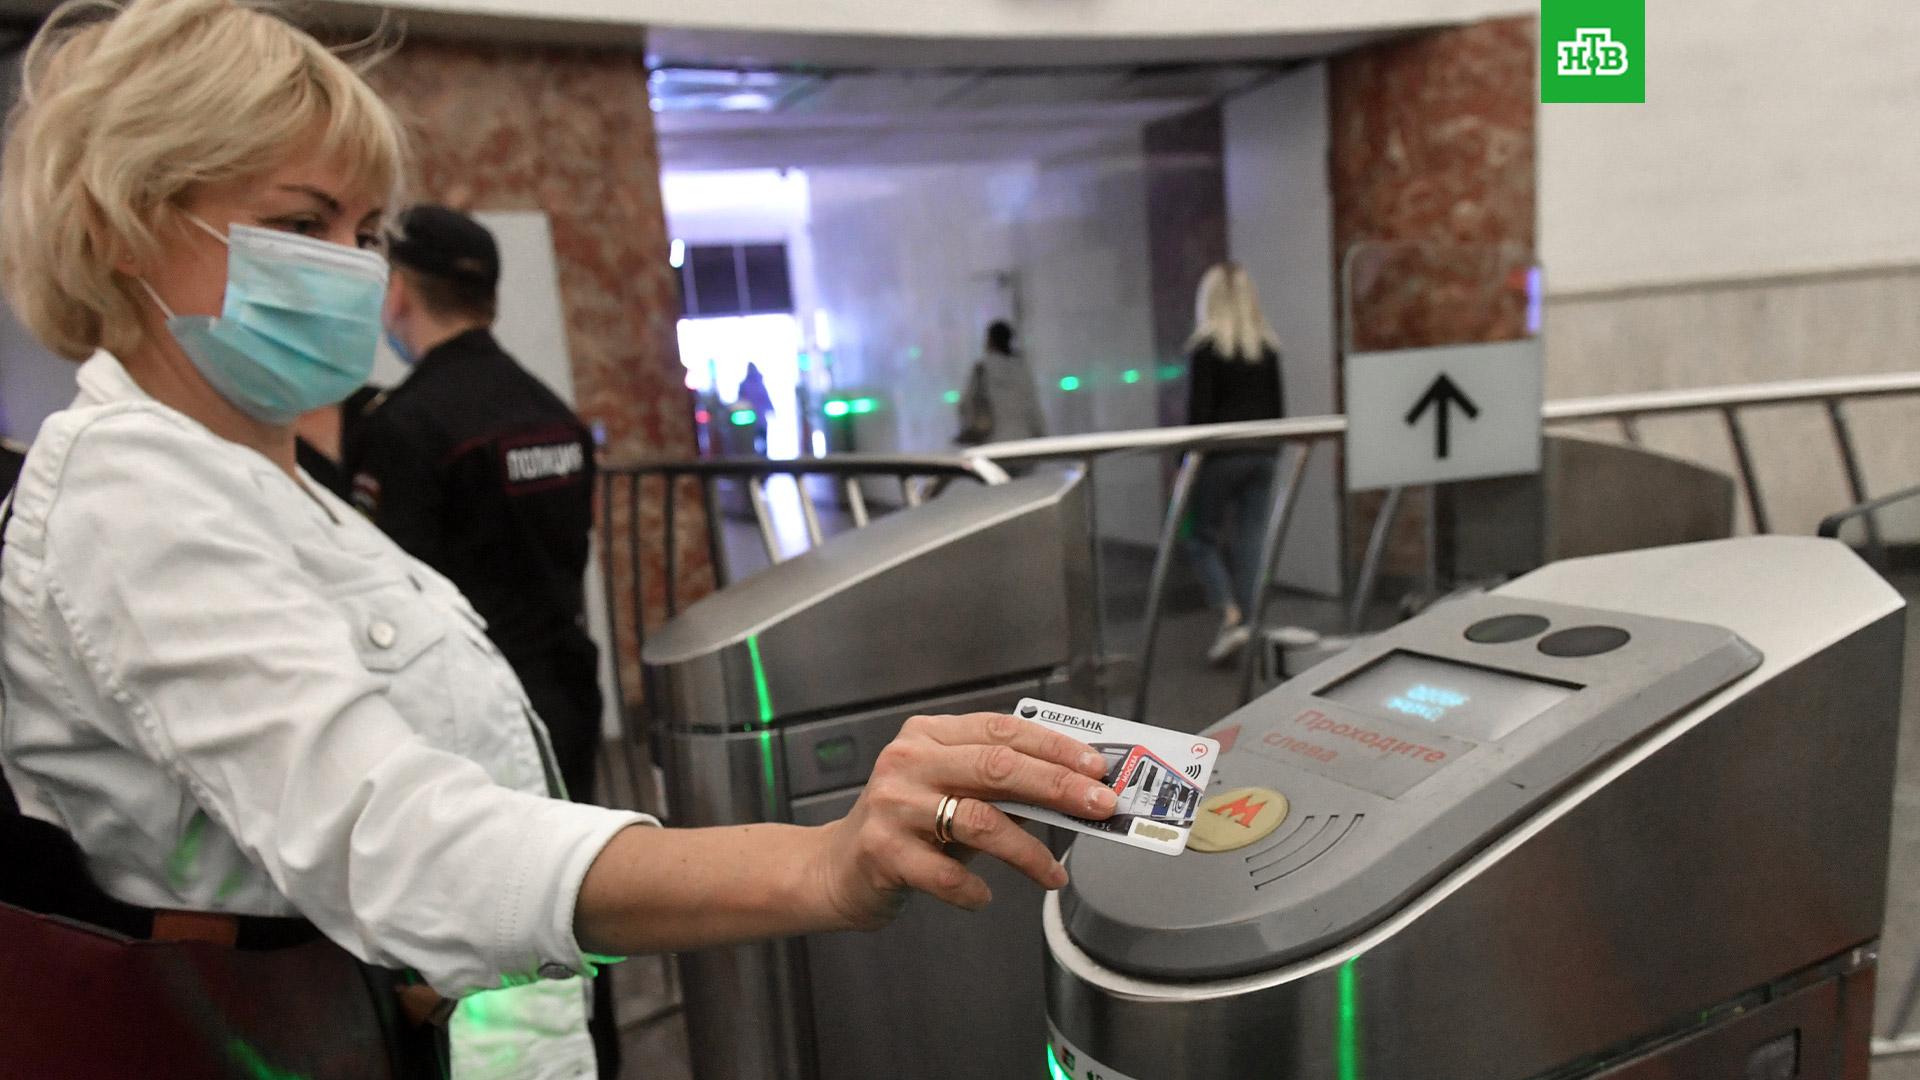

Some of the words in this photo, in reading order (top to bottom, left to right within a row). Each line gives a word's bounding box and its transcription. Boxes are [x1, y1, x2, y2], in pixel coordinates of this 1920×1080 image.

[506, 442, 583, 482] ПОЛИЦИЯ
[1040, 708, 1105, 733] СБЕРБАНК
[1295, 710, 1447, 763] Проходите
